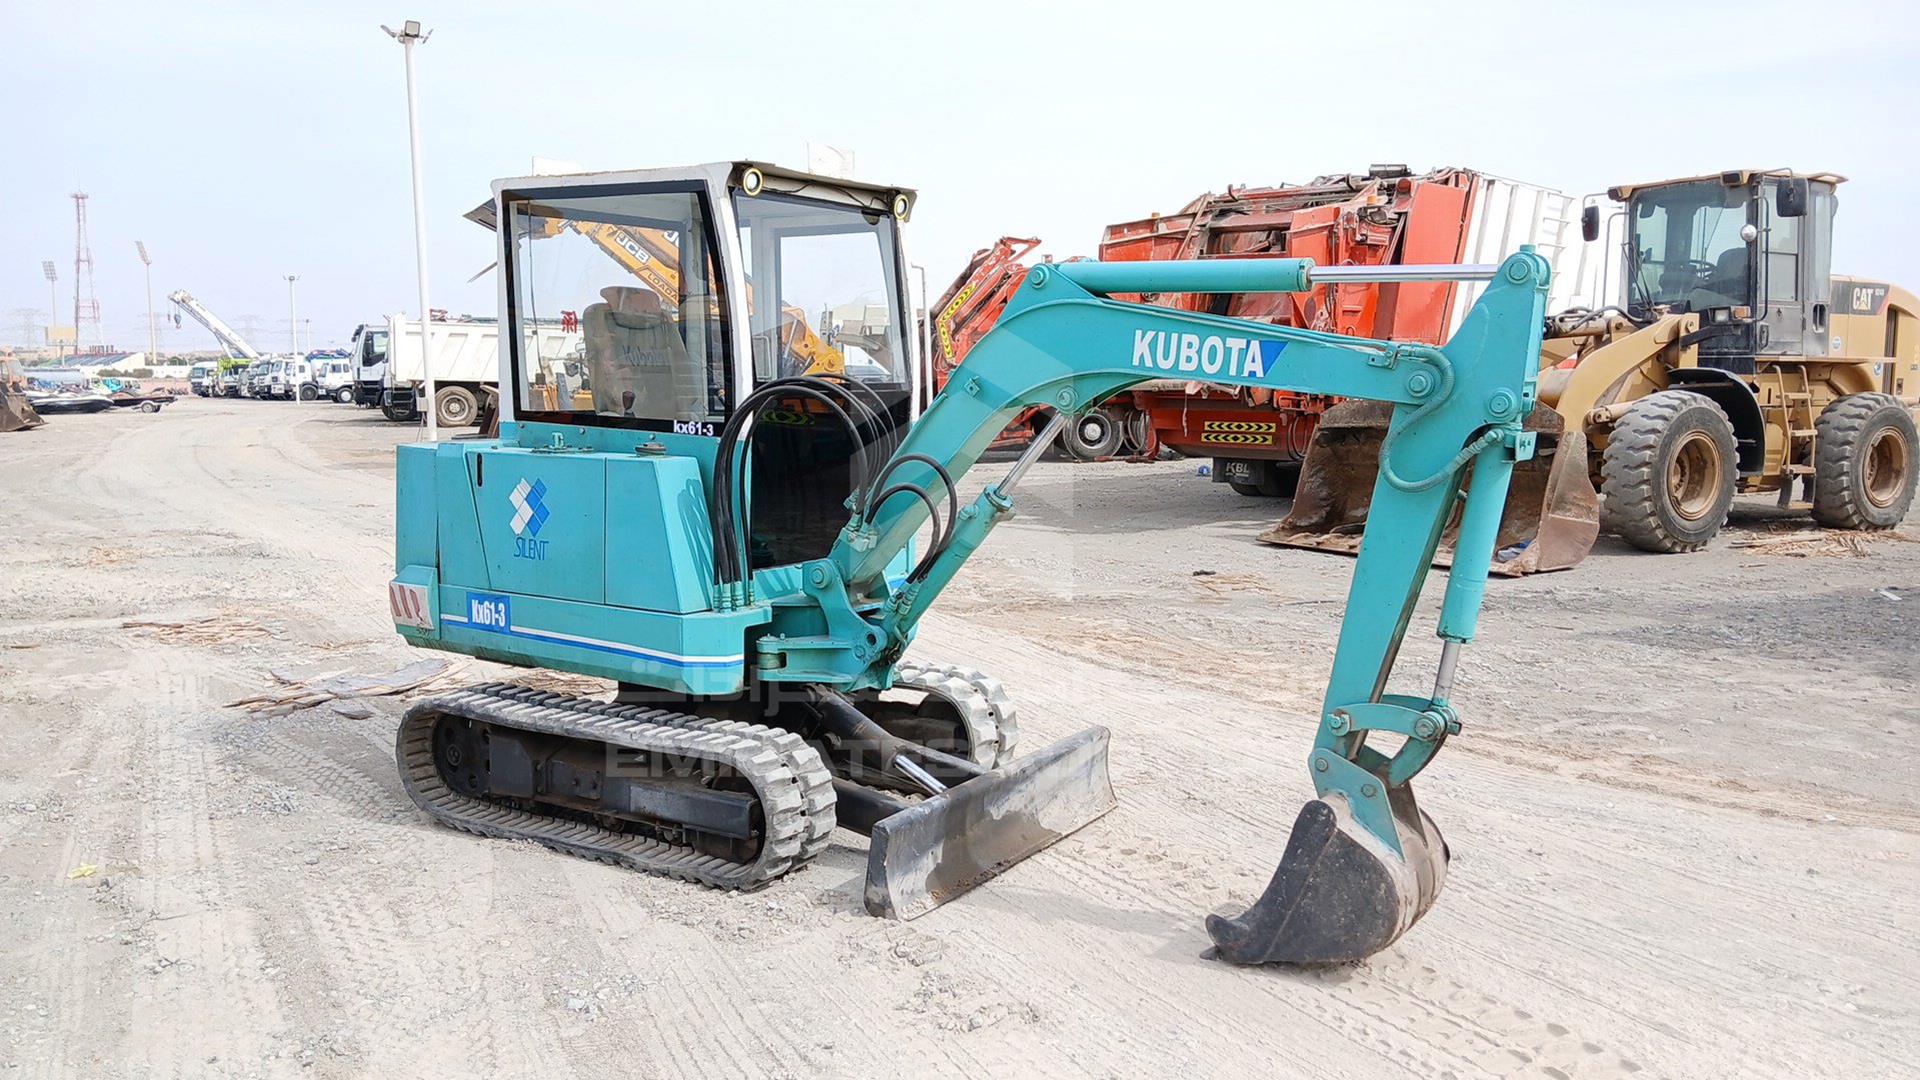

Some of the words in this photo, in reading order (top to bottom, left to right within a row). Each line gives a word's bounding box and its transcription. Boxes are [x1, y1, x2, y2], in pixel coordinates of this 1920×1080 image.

[616, 233, 650, 265] JCB
[1853, 287, 1874, 311] CAT
[1132, 329, 1264, 378] KUBOTA
[1226, 462, 1250, 474] KBL
[514, 537, 549, 561] SILENT
[471, 599, 506, 628] Kx61-3
